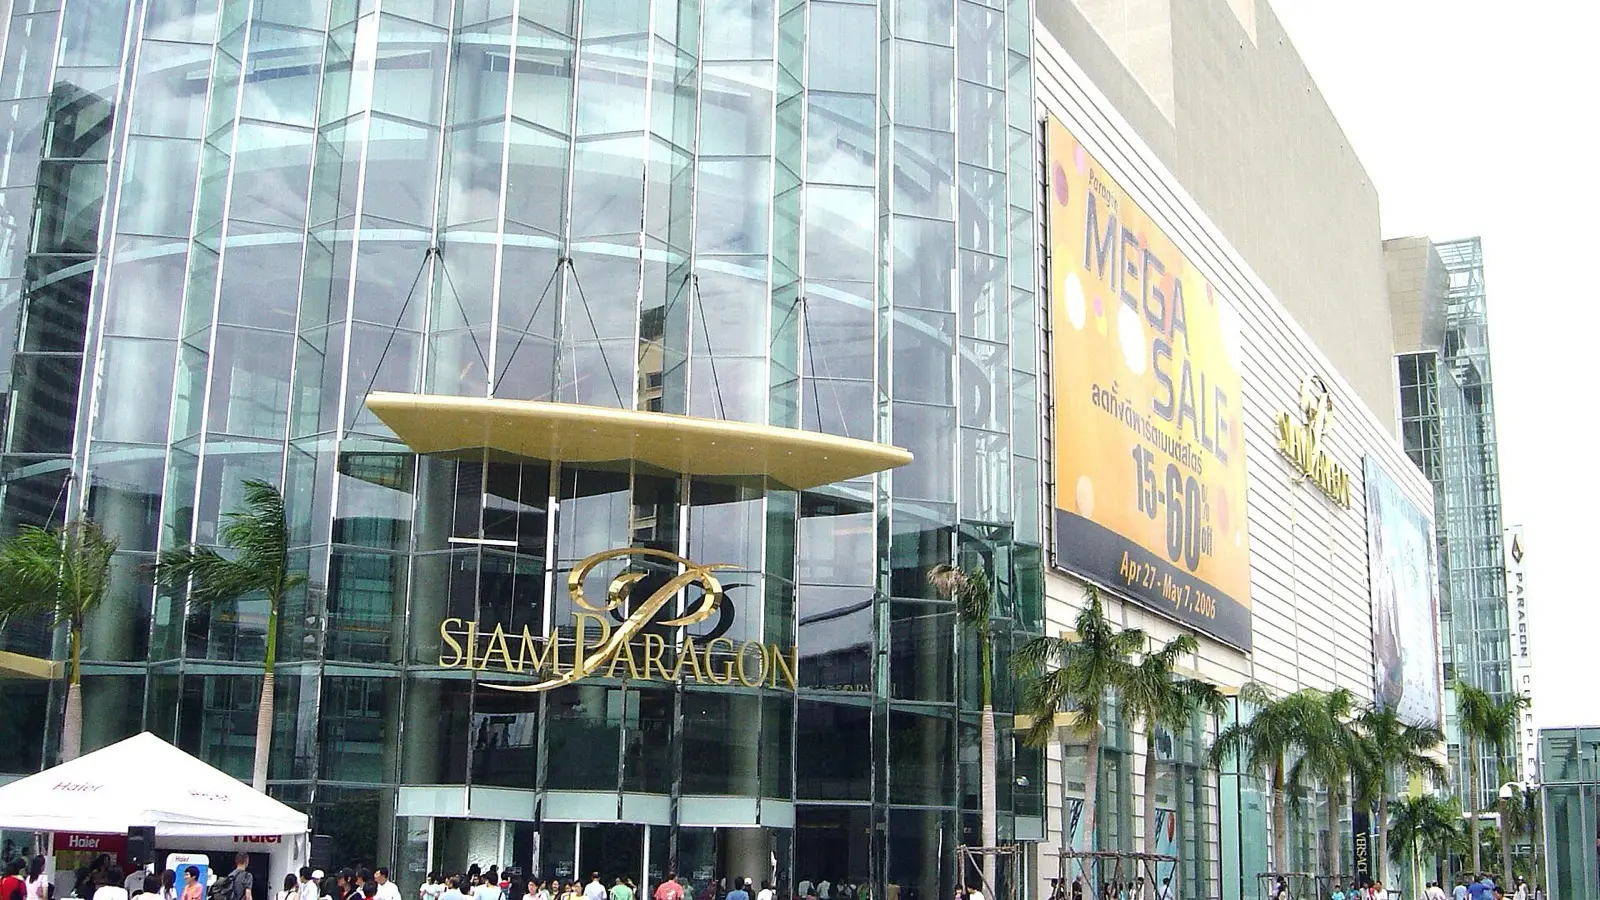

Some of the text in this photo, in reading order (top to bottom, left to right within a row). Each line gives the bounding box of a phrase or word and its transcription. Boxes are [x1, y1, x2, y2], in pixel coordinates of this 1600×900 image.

[1089, 167, 1119, 213] Paragon
[1084, 189, 1190, 356] MEGA
[1152, 337, 1228, 467] SALE
[1201, 525, 1213, 557] off
[1120, 551, 1141, 586] Apr
[1142, 562, 1156, 590] 27
[1162, 573, 1182, 611] May
[1184, 584, 1193, 613] 7,
[1194, 590, 1216, 620] 2006
[1515, 572, 1528, 658] PARAGON
[438, 611, 798, 692] SIAM PARAGON
[1522, 674, 1536, 786] CIEPLEX
[52, 781, 105, 792] Haier
[69, 834, 101, 848] Haier
[1356, 831, 1368, 875] VERSACE
